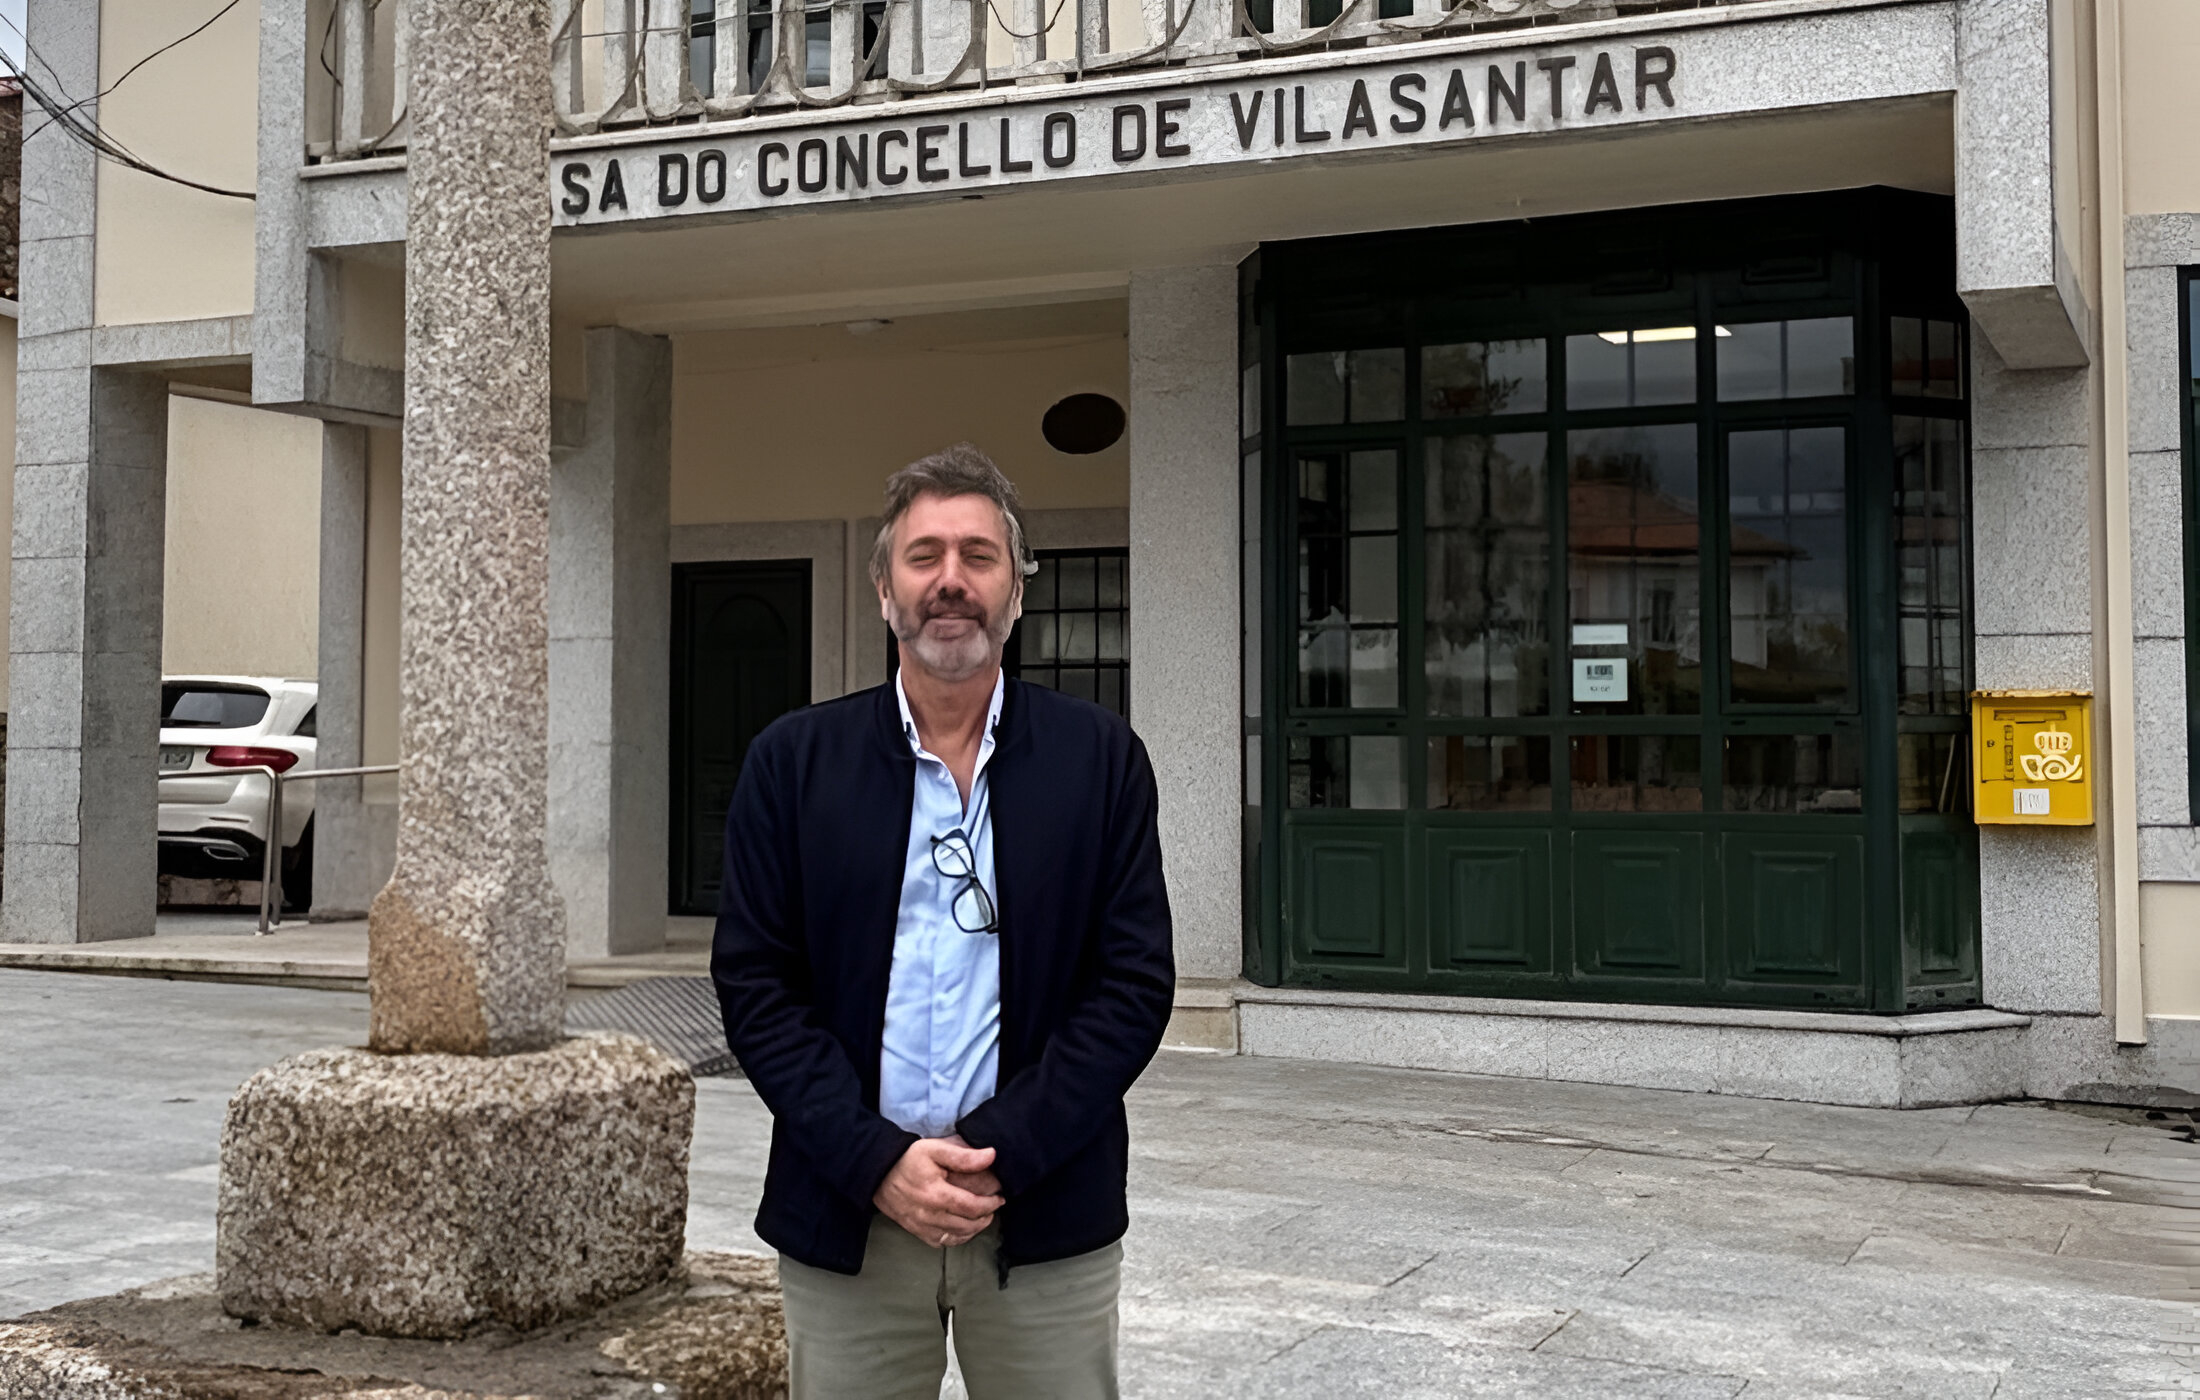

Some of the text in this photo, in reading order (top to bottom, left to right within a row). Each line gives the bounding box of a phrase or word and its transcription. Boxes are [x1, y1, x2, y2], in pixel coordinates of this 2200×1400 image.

[658, 149, 727, 207] DO
[757, 111, 1076, 197] CONCELLO
[1111, 98, 1191, 162] DE
[1229, 46, 1675, 149] VILASANTAR
